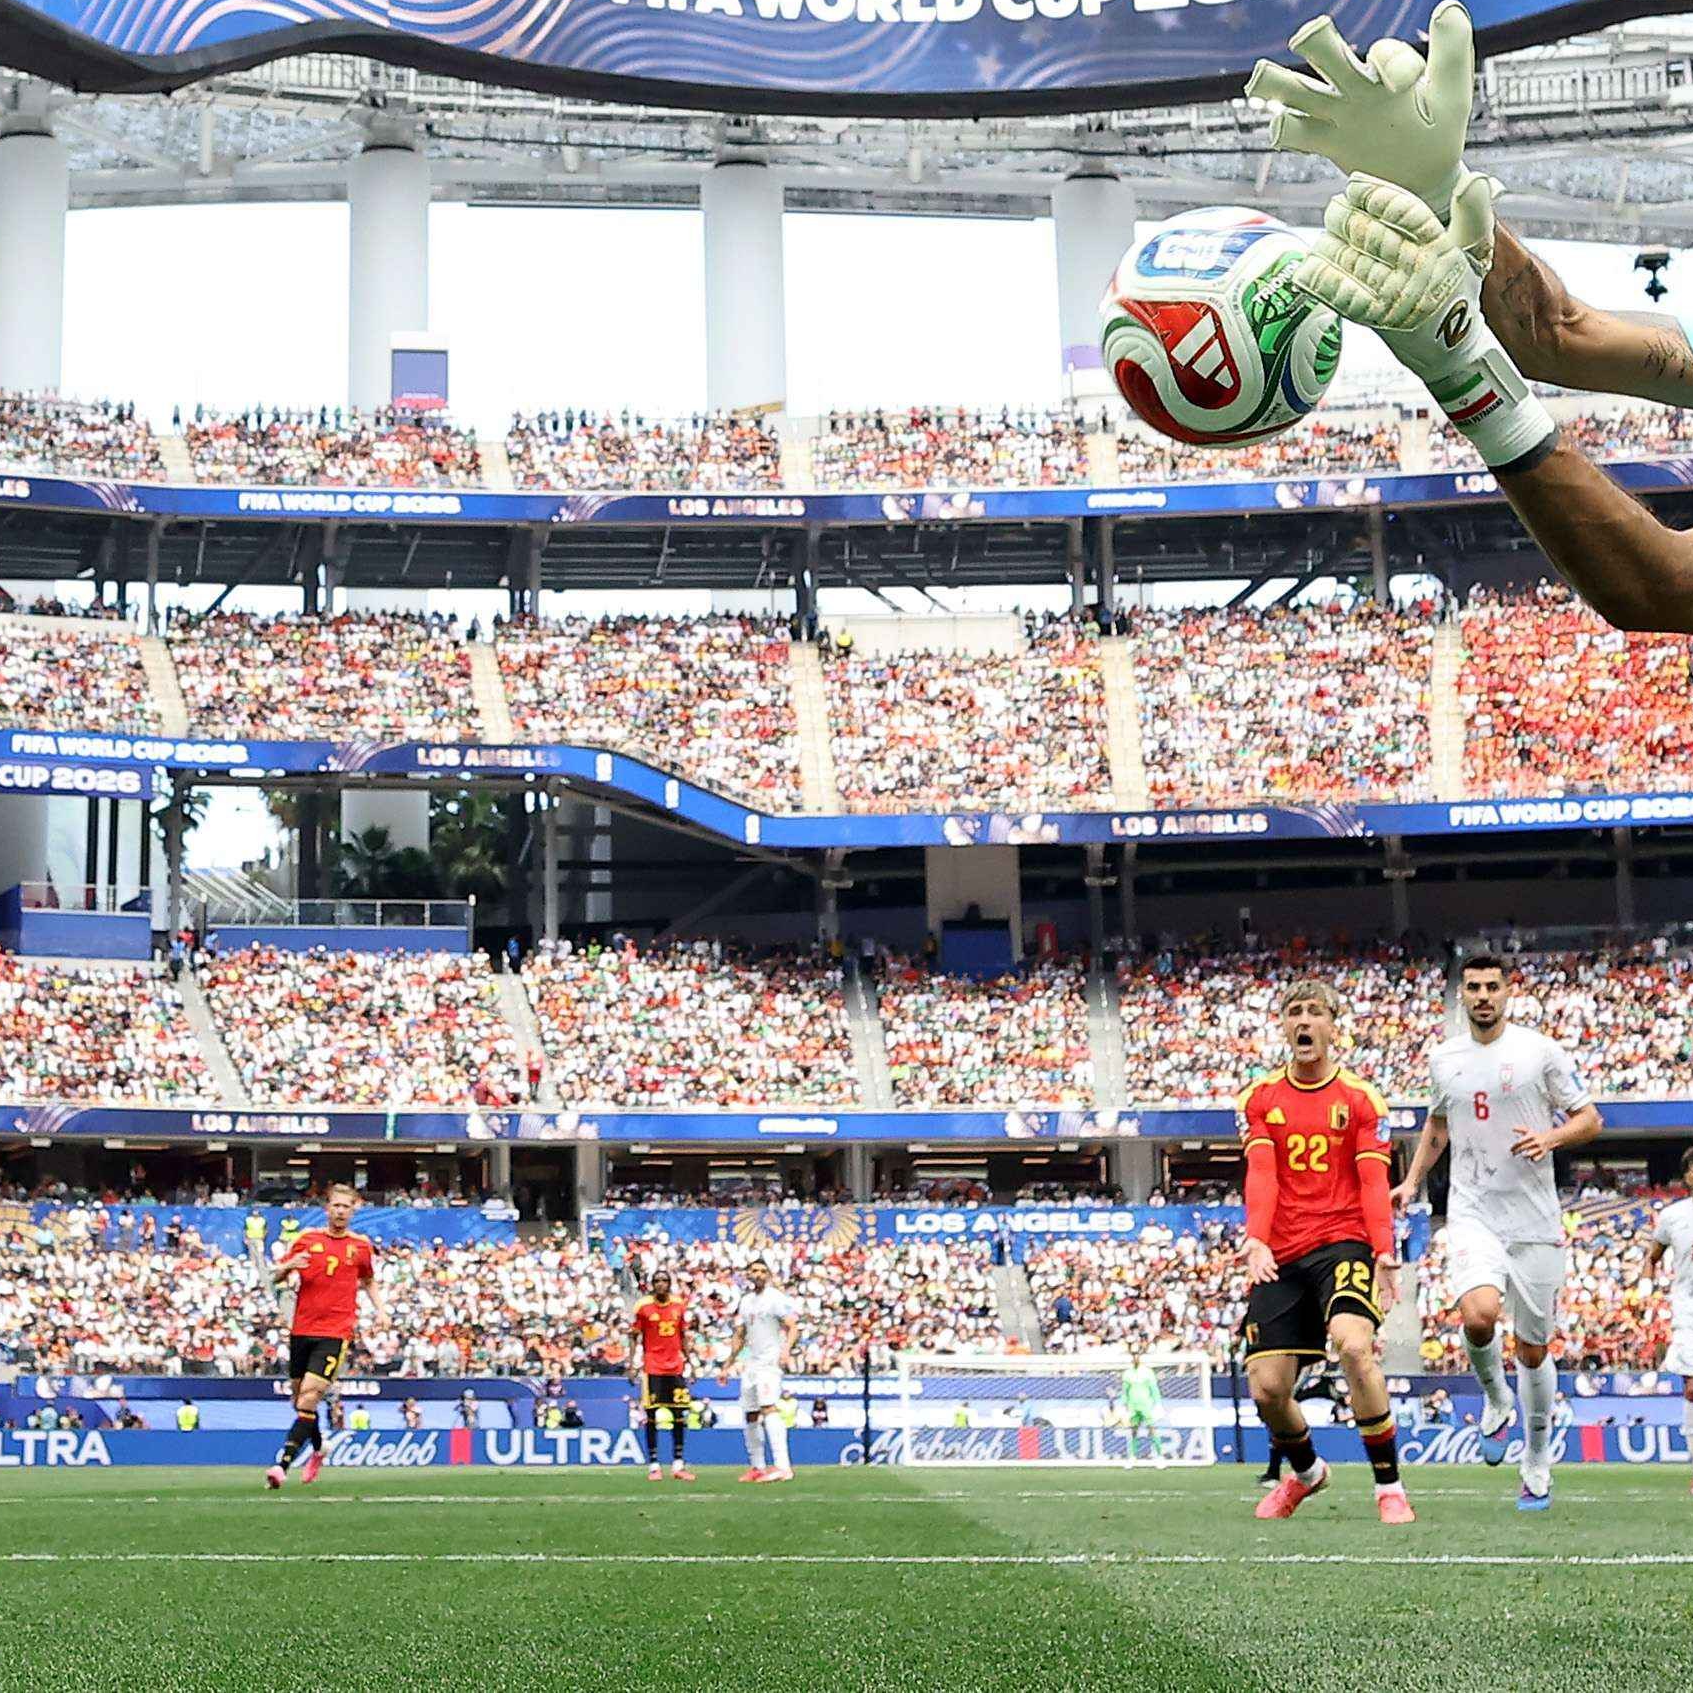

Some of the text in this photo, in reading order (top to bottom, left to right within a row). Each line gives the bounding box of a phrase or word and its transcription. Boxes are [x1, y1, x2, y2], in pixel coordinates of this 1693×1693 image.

[668, 499, 709, 516] LOS
[11, 735, 56, 754] FIFA
[58, 736, 131, 758] WORLD
[133, 740, 174, 760] CUP
[417, 748, 460, 766] LOS
[51, 767, 141, 793] 2026
[1111, 813, 1268, 836] LOS ANGELES
[1449, 805, 1499, 826] FIFA
[1501, 801, 1582, 824] WORLD
[1583, 799, 1629, 821] CUP
[1474, 1091, 1490, 1121] 6
[191, 1114, 231, 1132] LOS
[1287, 1134, 1329, 1172] 22
[895, 1212, 1135, 1233] LOS ANGELES
[1334, 1260, 1371, 1293] 22
[324, 1356, 337, 1376] 7
[486, 1429, 645, 1465] ULTRA
